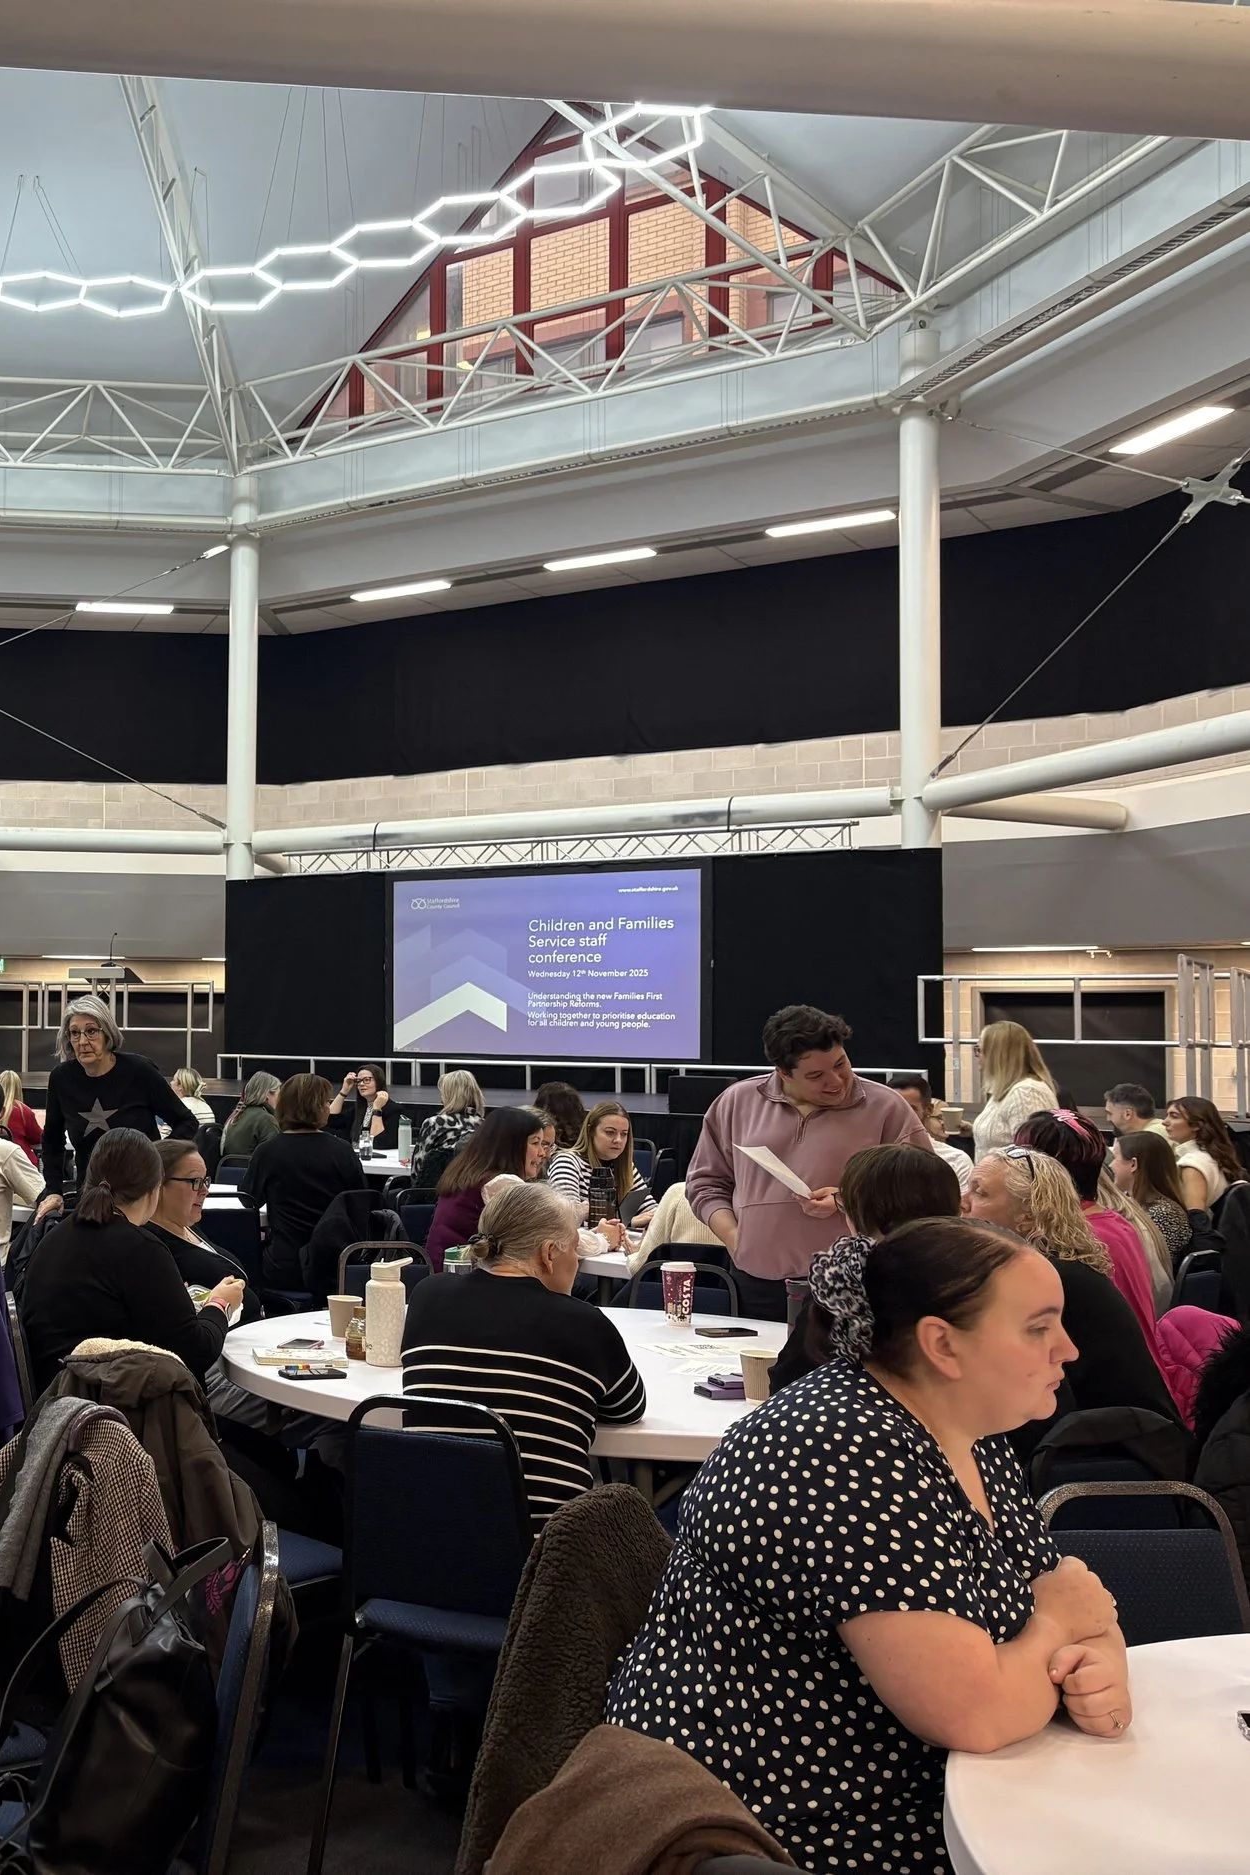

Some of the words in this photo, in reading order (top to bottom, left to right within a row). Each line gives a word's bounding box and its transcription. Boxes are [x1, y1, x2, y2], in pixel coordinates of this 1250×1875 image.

[528, 919, 585, 932] Children
[588, 917, 614, 931] and
[618, 916, 675, 930] Families
[528, 935, 576, 948] Service
[579, 933, 608, 947] staff
[528, 950, 602, 964] conference
[528, 970, 571, 979] Wednesday
[588, 969, 628, 977] November
[629, 969, 649, 977] 2025
[528, 992, 581, 1001] Understanding
[583, 992, 596, 1000] the
[614, 992, 645, 1000] Families
[646, 992, 663, 1000] First
[528, 1000, 568, 1009] Partnership
[569, 1000, 602, 1008] Reforms.
[527, 1011, 558, 1020] Working
[559, 1011, 591, 1020] together
[593, 1012, 600, 1020] to
[602, 1011, 635, 1020] prioritise
[637, 1011, 676, 1020] education
[527, 1019, 538, 1027] for
[539, 1019, 548, 1027] all
[549, 1019, 578, 1027] children
[596, 1021, 620, 1029] young
[621, 1020, 651, 1029] people.
[682, 1279, 691, 1315] COSTA
